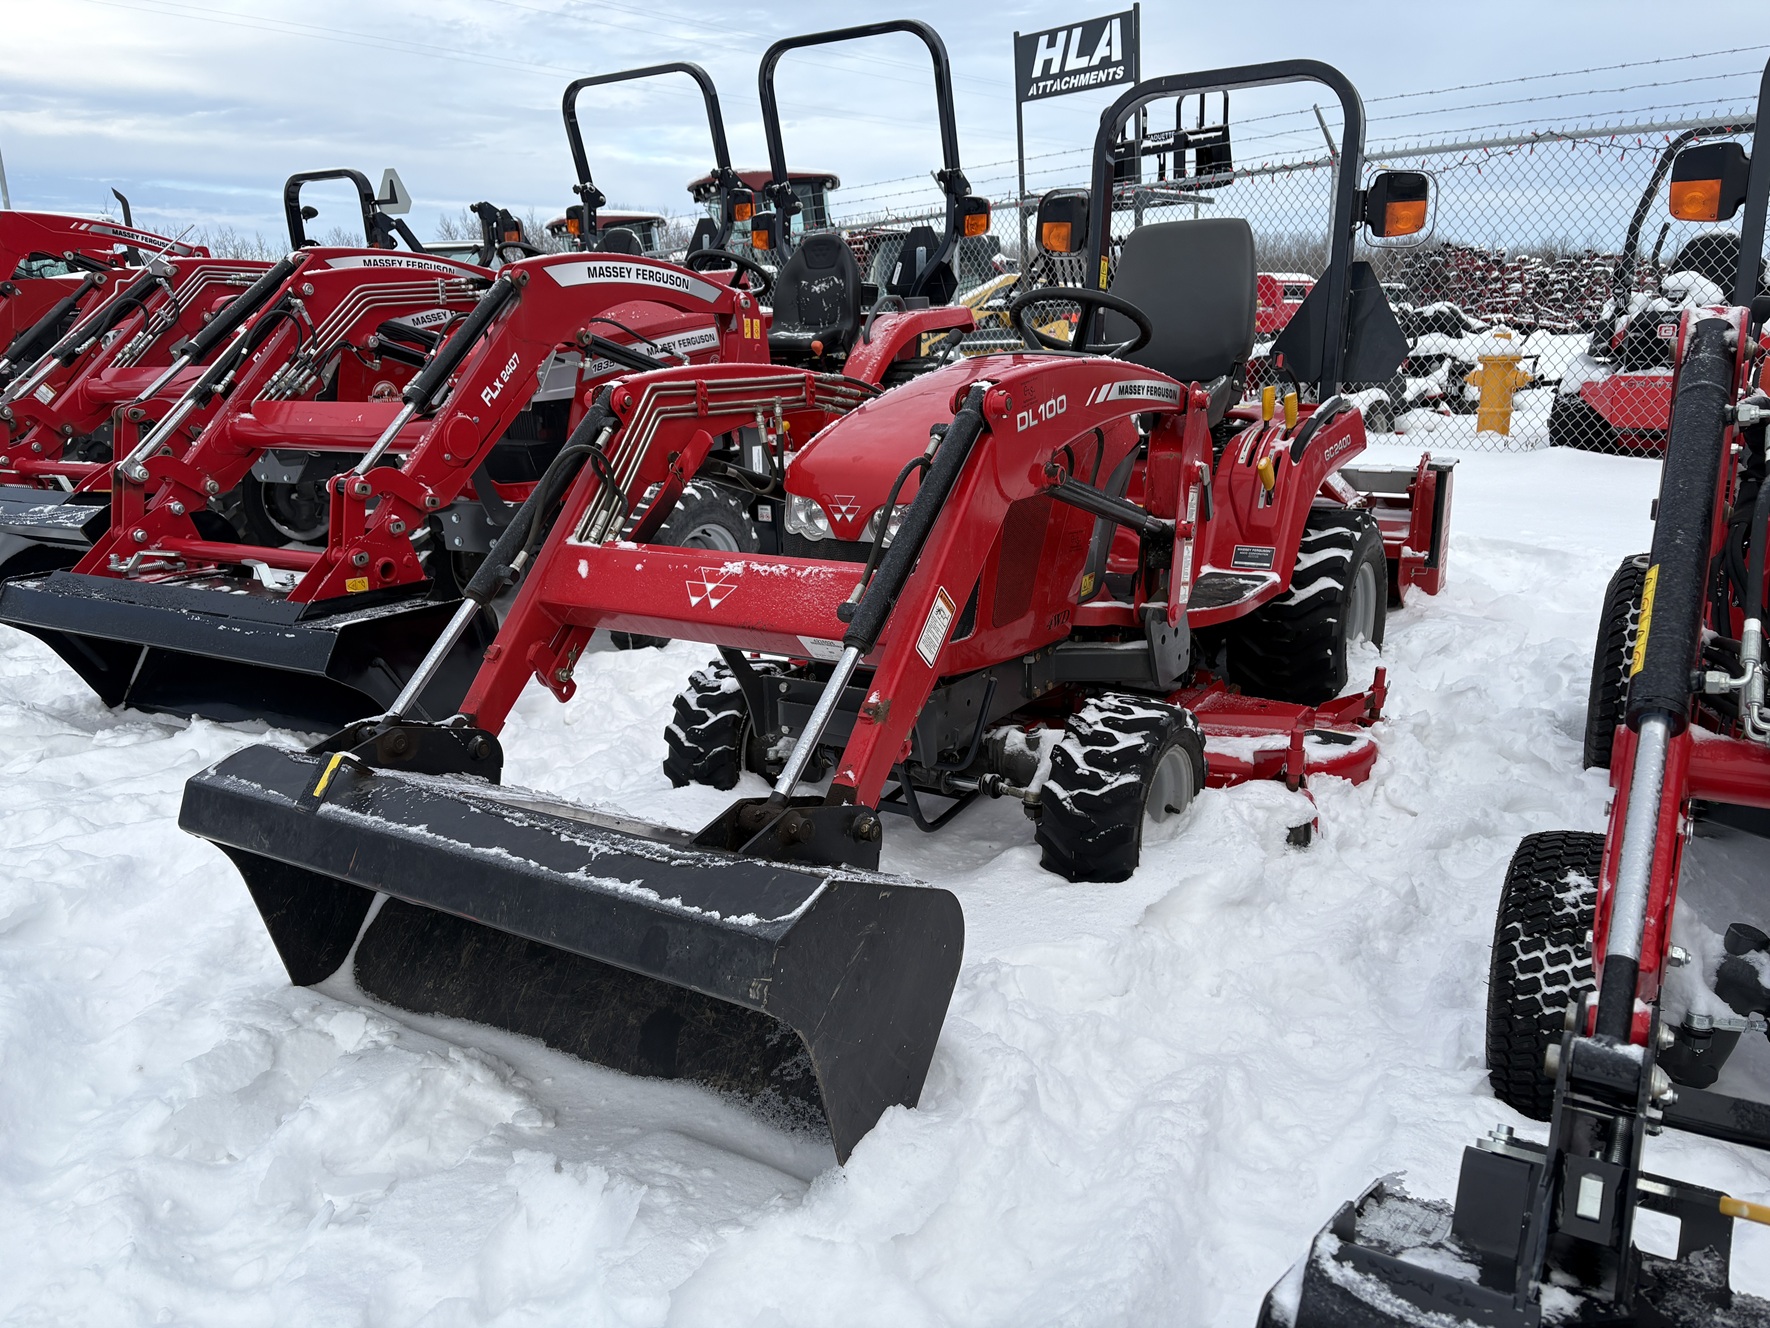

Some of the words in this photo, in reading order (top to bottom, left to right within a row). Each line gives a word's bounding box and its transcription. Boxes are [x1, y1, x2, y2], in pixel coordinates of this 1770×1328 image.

[1032, 17, 1122, 78] HLA
[1028, 66, 1124, 96] ATTACHMENTS
[112, 229, 140, 241] MASSEY
[141, 233, 175, 251] FERGUSON
[363, 258, 403, 267] MASSEY
[406, 260, 455, 275] FERGUSON
[587, 266, 632, 278] MASSEY
[636, 268, 689, 290] FERGUSON
[412, 311, 447, 327] MASSEY
[678, 334, 715, 348] FERGUSON
[592, 360, 615, 373] 1835
[481, 378, 504, 407] FLX
[500, 352, 520, 383] 2407
[1118, 385, 1145, 396] MASSEY
[1146, 385, 1178, 401] FERGUSON
[1324, 433, 1352, 461] GC2400
[1047, 609, 1070, 630] 4WD
